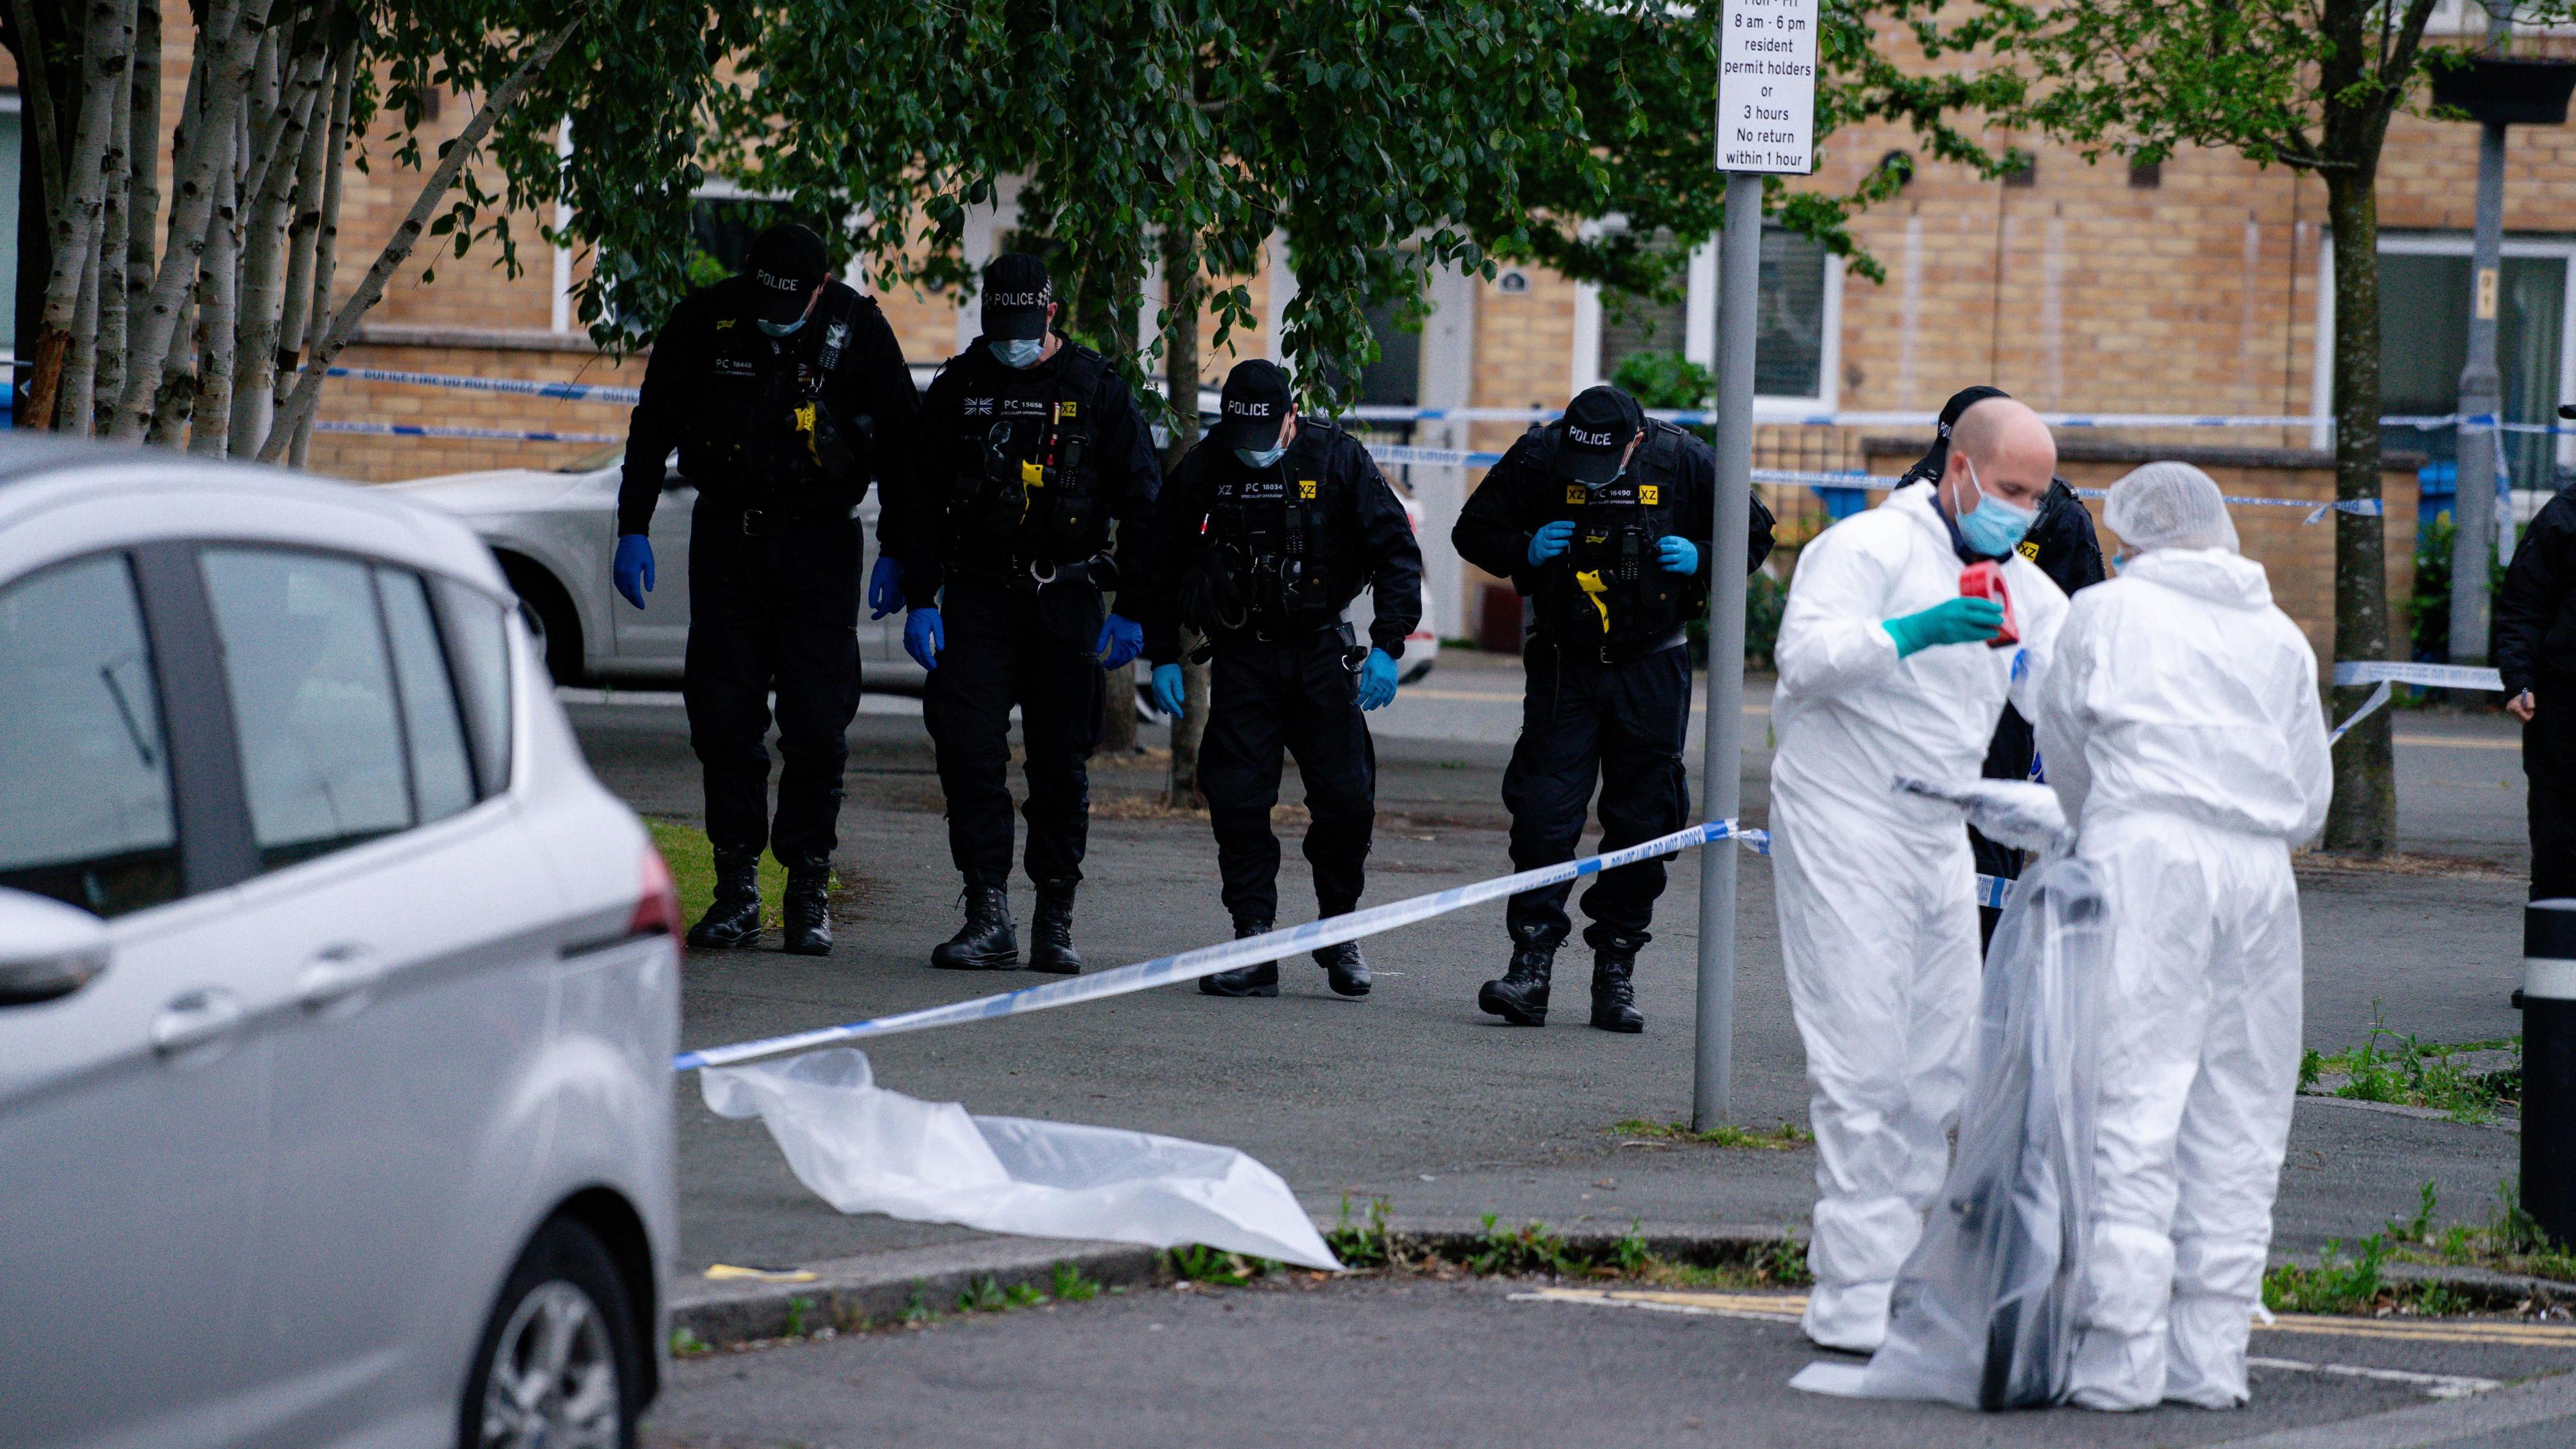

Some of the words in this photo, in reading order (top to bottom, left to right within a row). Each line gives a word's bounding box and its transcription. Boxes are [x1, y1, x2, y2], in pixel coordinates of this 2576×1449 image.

[1735, 13, 1742, 28] 8
[1747, 17, 1764, 28] am
[1776, 15, 1784, 29] 6
[1788, 19, 1805, 32] pm
[1745, 38, 1793, 52] resident
[1725, 60, 1764, 75] permit
[1768, 62, 1811, 76] holders
[1761, 86, 1773, 97] or
[1743, 105, 1751, 119] 3
[1756, 106, 1789, 121] hours
[1737, 127, 1753, 142] No
[1758, 129, 1794, 144] return
[1726, 151, 1762, 165] within
[1767, 152, 1771, 165] 1
[1776, 152, 1803, 166] hour
[756, 268, 799, 291] POLICE
[994, 292, 1034, 306] POLICE
[716, 359, 730, 368] PC
[1004, 400, 1019, 409] PC
[1062, 404, 1075, 414] XZ
[1227, 400, 1270, 416] POLICE
[1568, 425, 1612, 445] POLICE
[1939, 421, 1952, 439] POL
[1218, 484, 1233, 496] XZ
[1245, 482, 1260, 492] PC
[1299, 484, 1315, 494] XZ
[1594, 489, 1607, 499] PC
[1568, 490, 1585, 500] XZ
[1641, 490, 1657, 500] XZ
[2019, 544, 2037, 559] XZ
